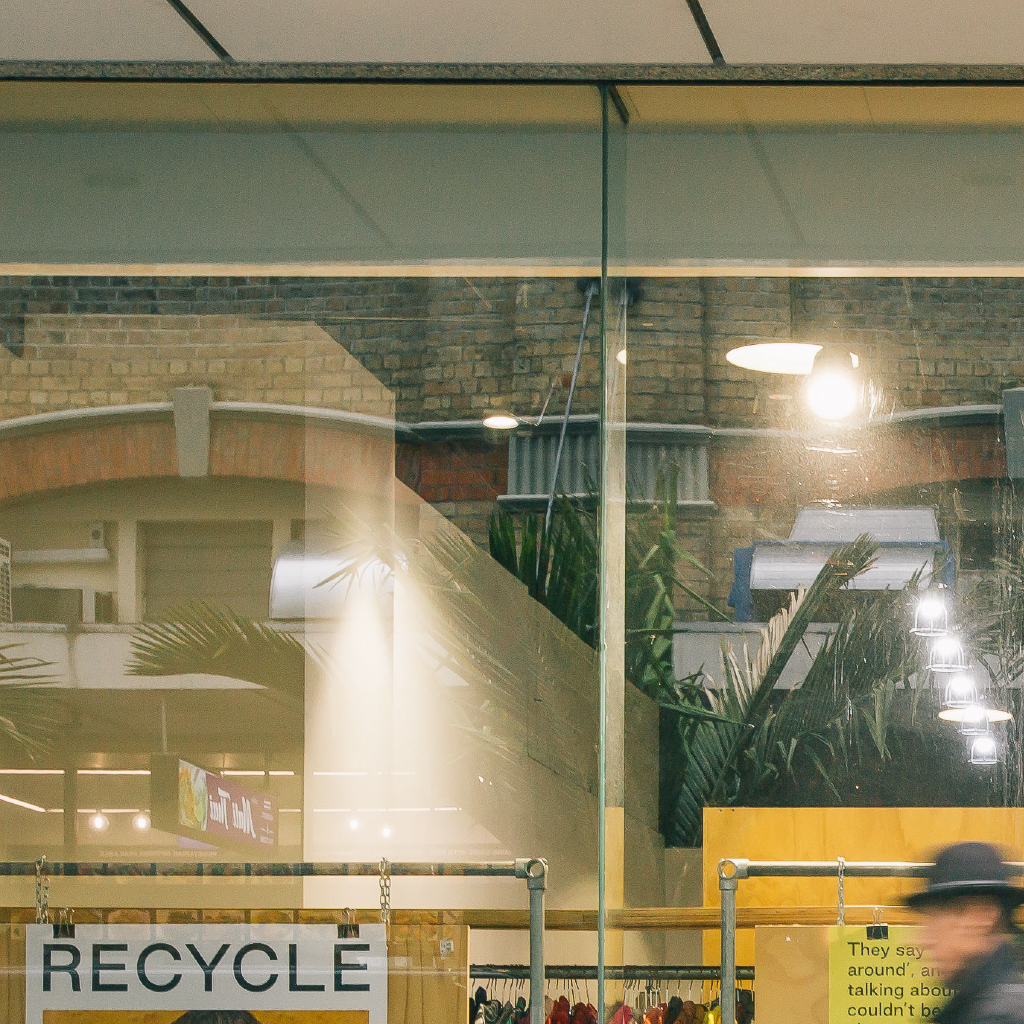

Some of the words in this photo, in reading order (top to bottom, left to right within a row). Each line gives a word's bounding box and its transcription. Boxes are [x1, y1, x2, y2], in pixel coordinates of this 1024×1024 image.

[847, 941, 890, 959] They
[896, 946, 925, 960] say
[42, 942, 371, 993] RECYCLE
[847, 982, 904, 1000] talking
[910, 983, 956, 997] abou
[847, 1002, 916, 1017] couldn't
